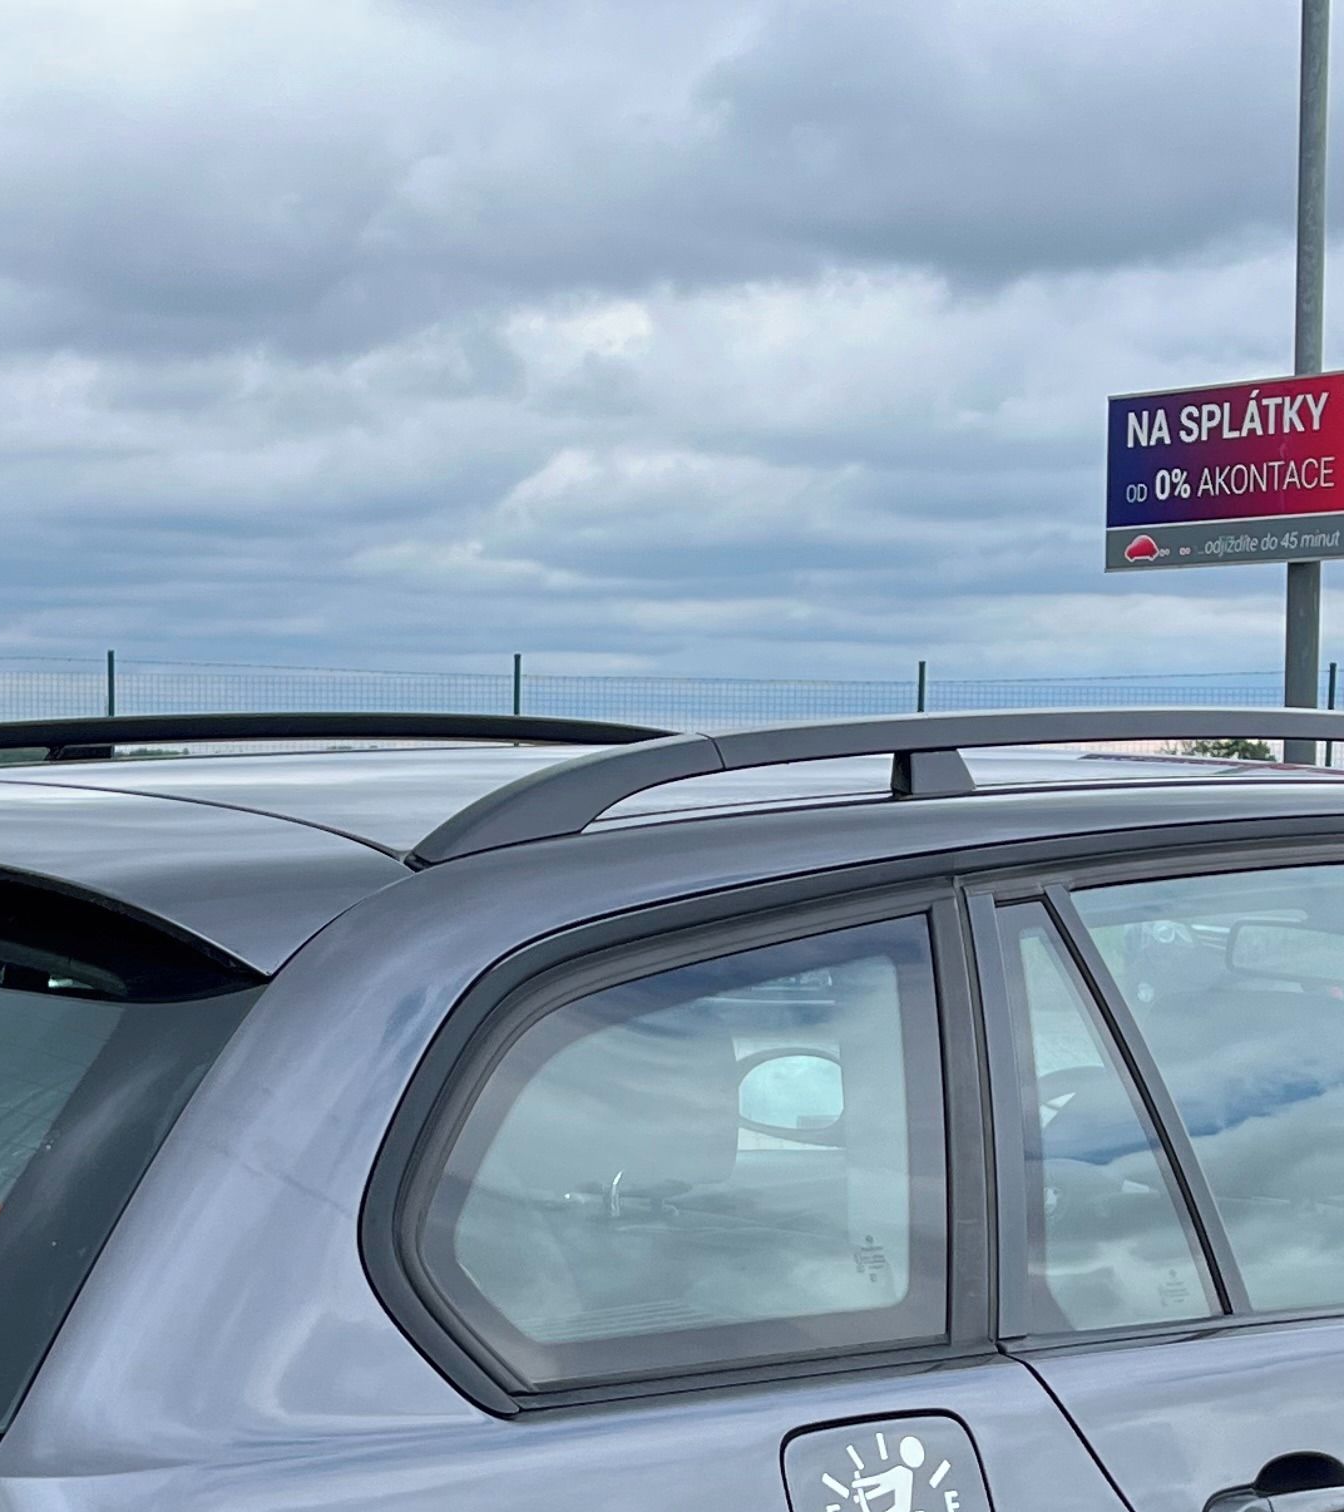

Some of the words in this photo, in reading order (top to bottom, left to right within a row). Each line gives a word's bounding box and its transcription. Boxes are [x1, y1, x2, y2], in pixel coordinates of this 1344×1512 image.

[1126, 407, 1171, 448] NA
[1179, 390, 1329, 443] SPLÁTKY
[1126, 483, 1148, 503] OD
[1155, 469, 1191, 501] 0%
[1197, 457, 1335, 497] AKONTACE
[1260, 533, 1278, 551] do
[1280, 531, 1298, 549] 45
[1300, 529, 1340, 549] minut
